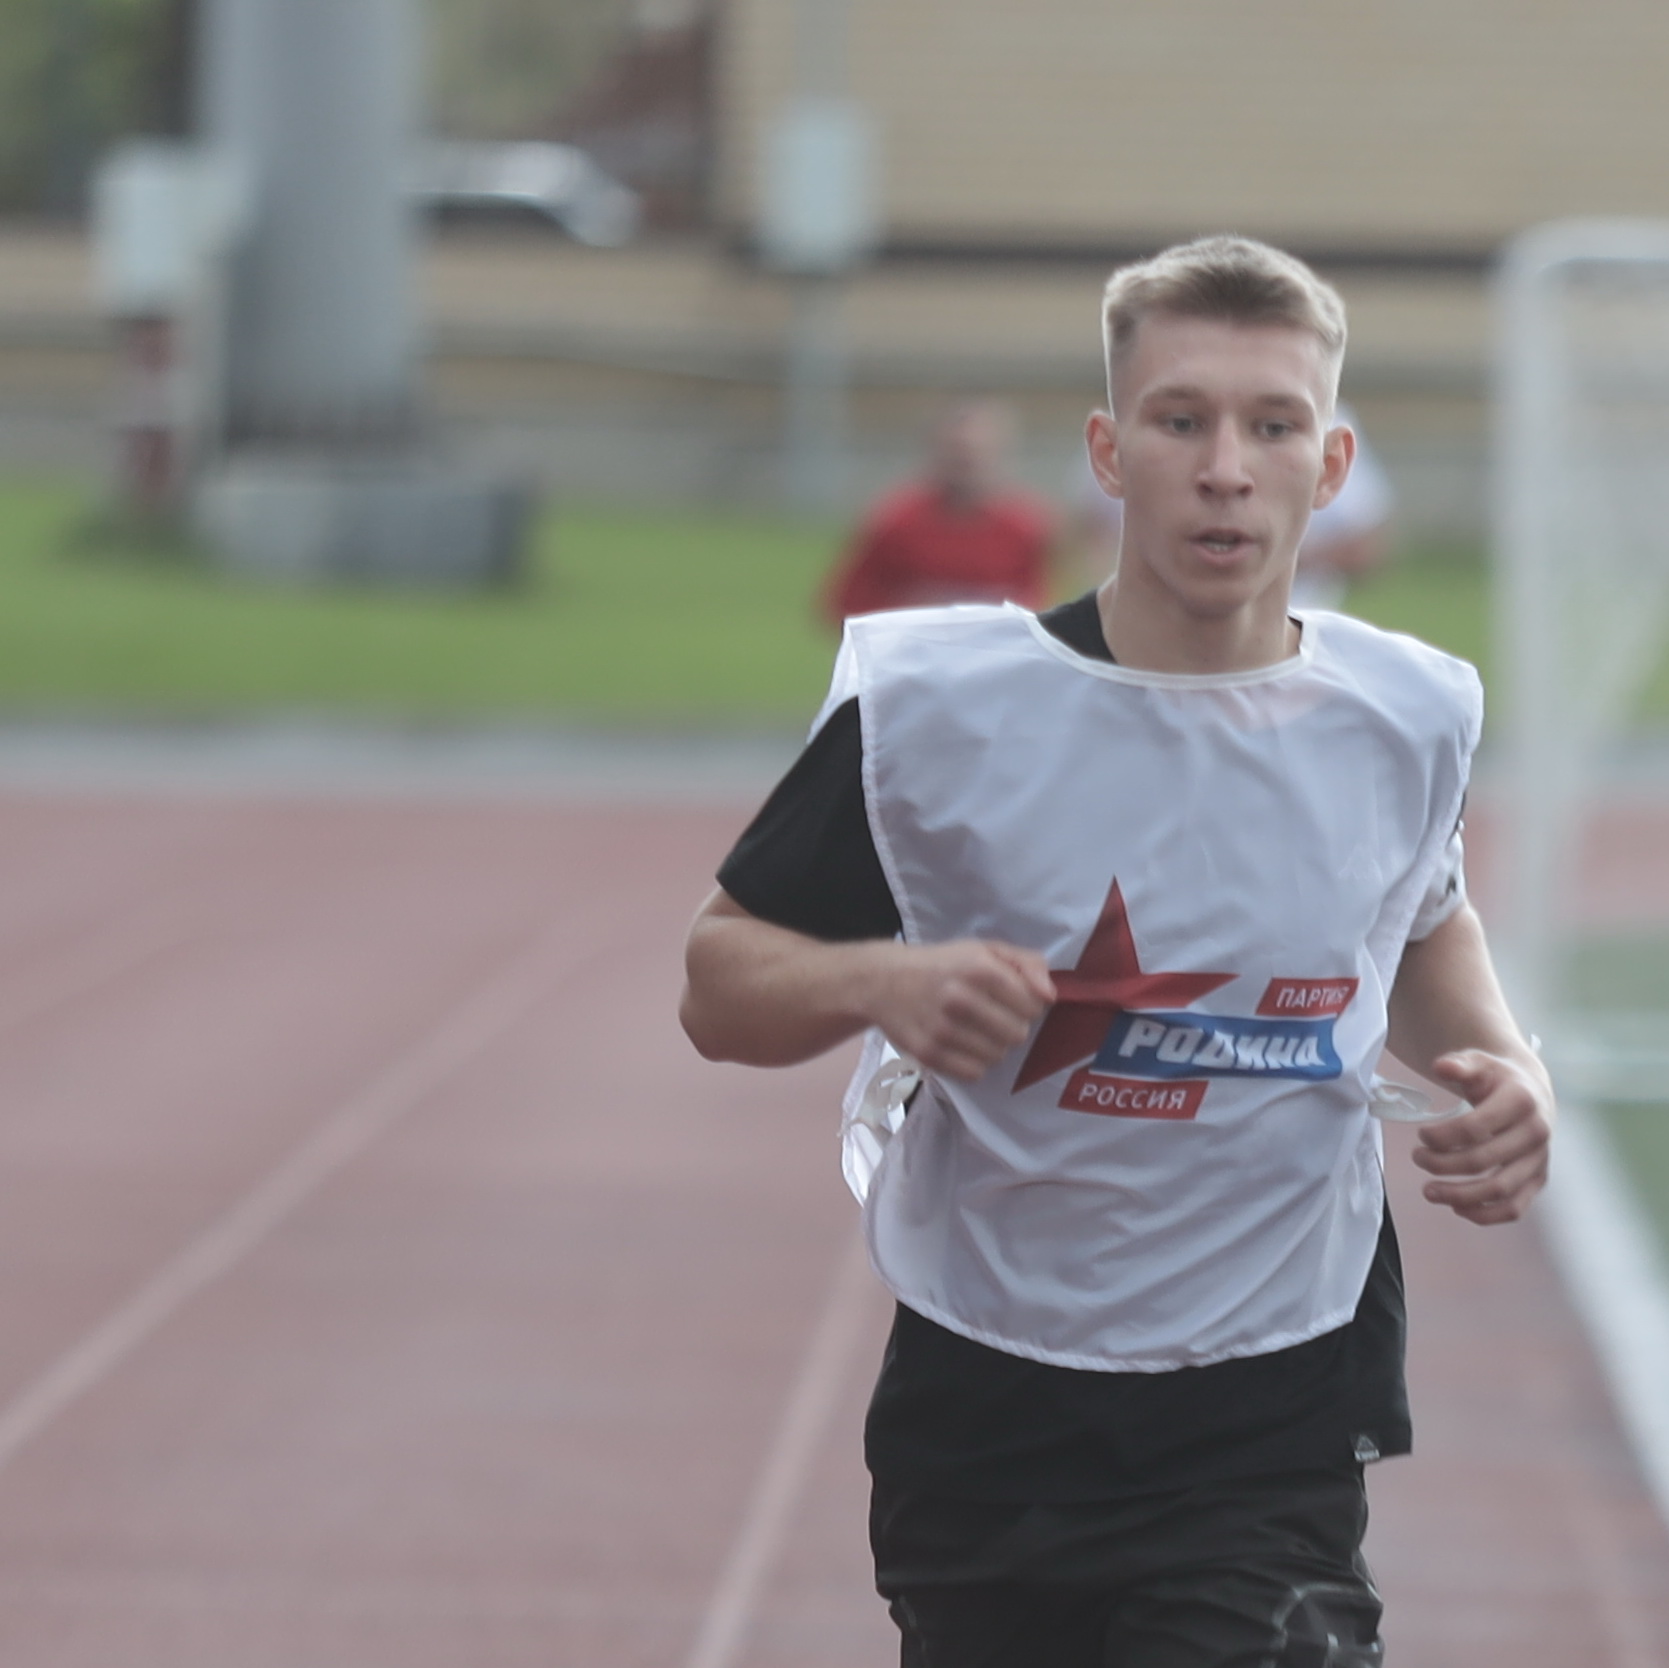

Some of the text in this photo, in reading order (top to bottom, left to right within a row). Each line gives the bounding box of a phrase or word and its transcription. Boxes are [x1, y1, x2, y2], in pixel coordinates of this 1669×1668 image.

[1276, 986, 1348, 1008] ПАРТИЯ
[1118, 1019, 1326, 1070] РОДИНА
[1079, 1084, 1188, 1110] РОССИЯ
